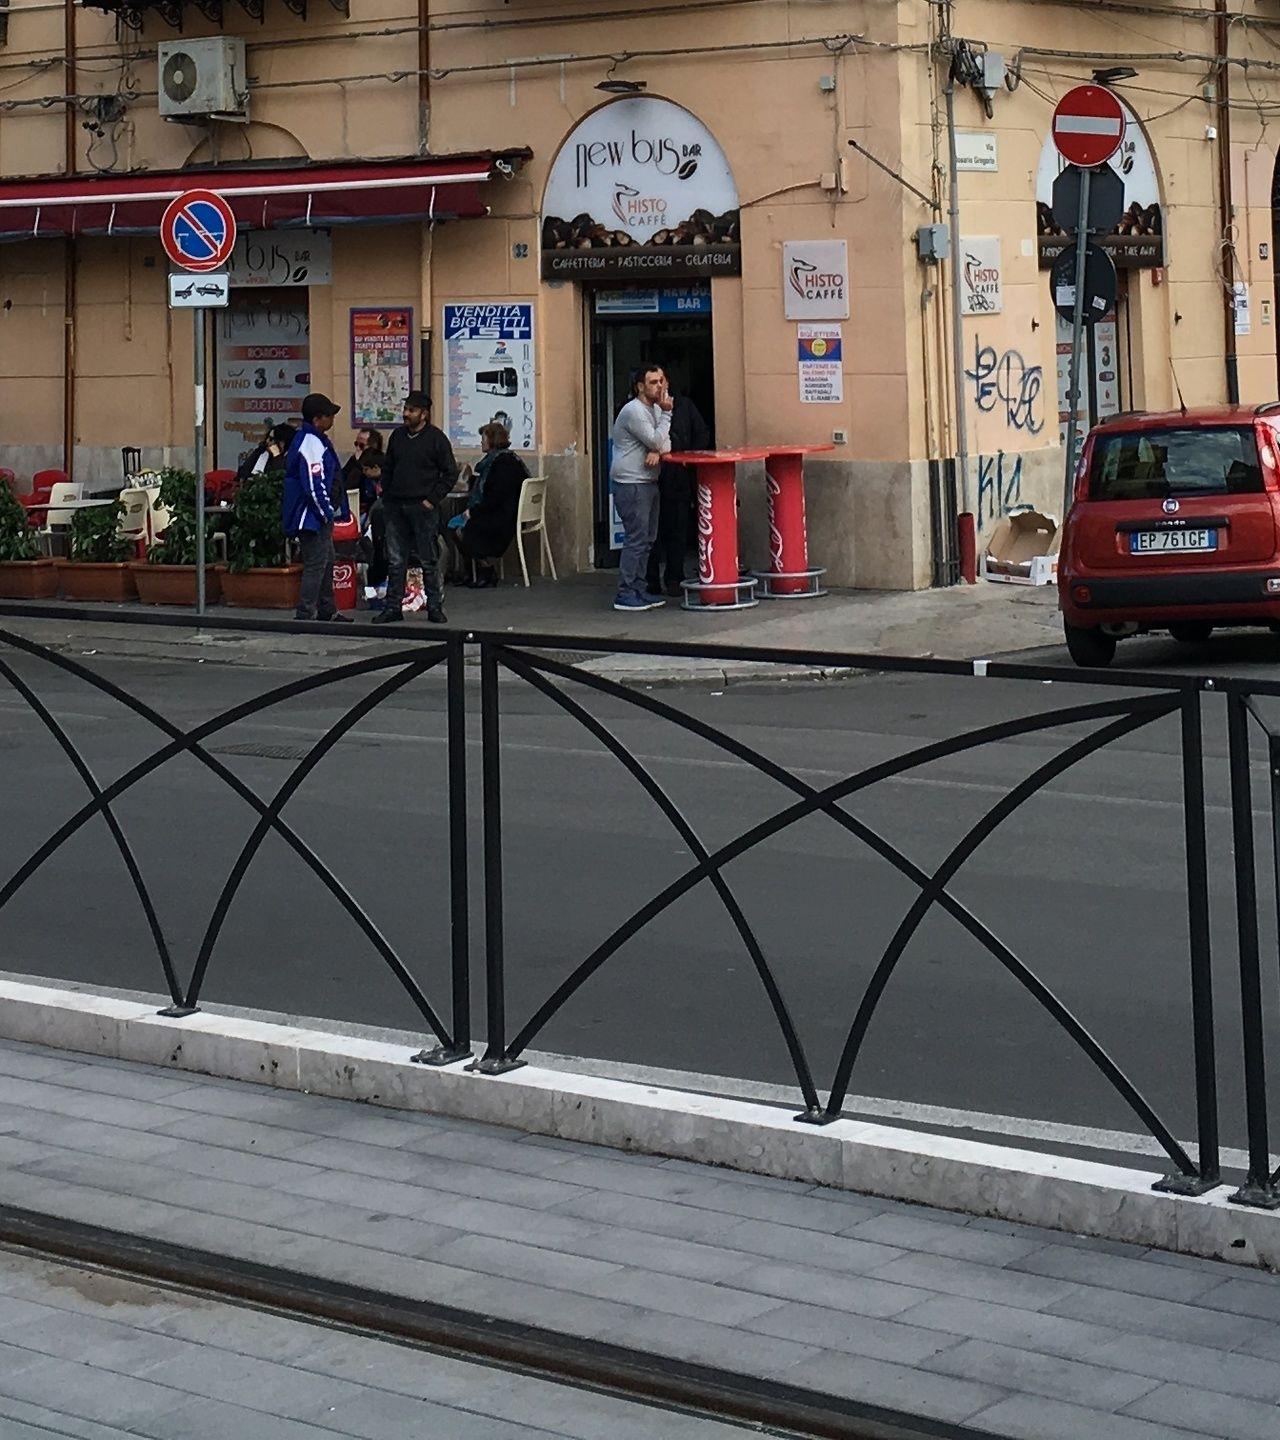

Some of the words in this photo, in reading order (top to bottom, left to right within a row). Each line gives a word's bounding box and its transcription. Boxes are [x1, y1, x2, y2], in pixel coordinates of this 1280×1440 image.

[985, 143, 994, 151] Via
[576, 140, 625, 188] new
[632, 130, 680, 175] bus
[683, 144, 702, 157] BAR
[628, 198, 667, 212] HISTO
[1124, 246, 1139, 256] TAKE
[1140, 246, 1156, 256] AWAY
[553, 258, 605, 269] CAFFETTERIA
[618, 256, 672, 268] PASTICCERIA
[686, 254, 731, 265] GELATERIA
[805, 274, 843, 287] HISTO
[974, 269, 999, 282] HISTO
[677, 298, 701, 309] BAR
[454, 306, 521, 317] VENDITA
[450, 317, 526, 329] BIGLIETTI
[449, 327, 530, 339] AST
[221, 378, 251, 389] WIND
[254, 367, 267, 389] 3
[1140, 533, 1157, 549] EP
[1163, 531, 1206, 548] 761GF
